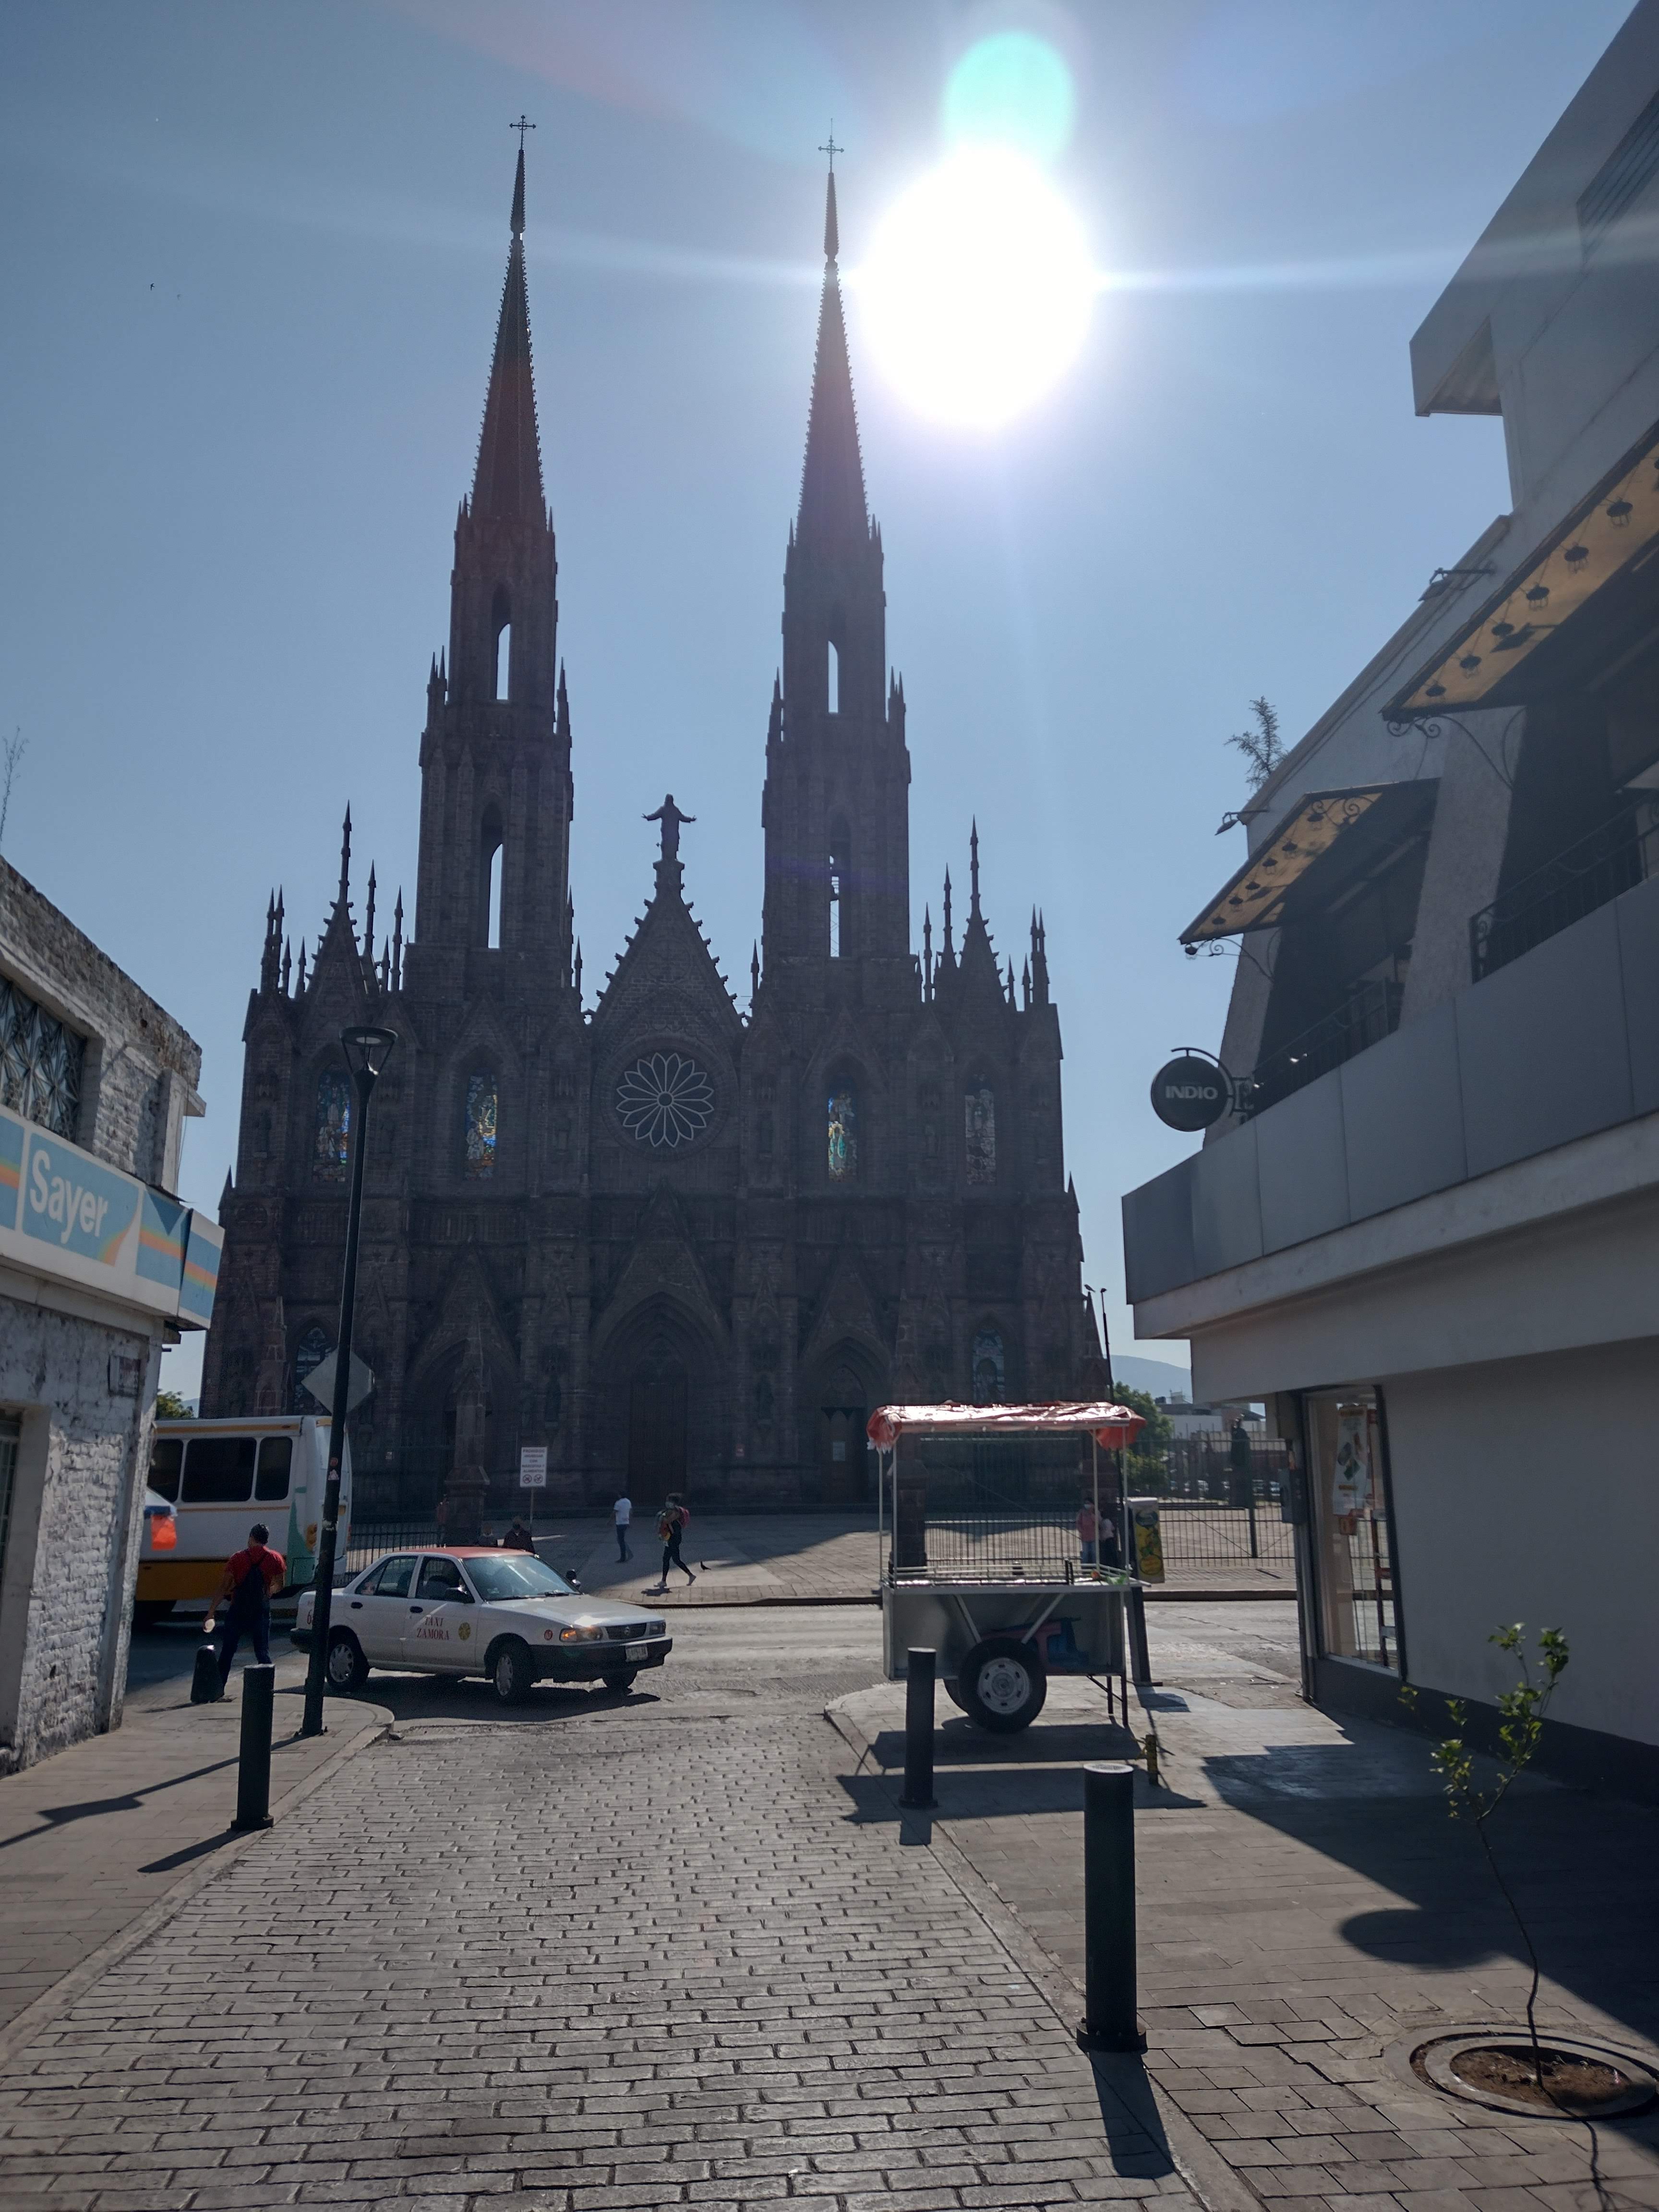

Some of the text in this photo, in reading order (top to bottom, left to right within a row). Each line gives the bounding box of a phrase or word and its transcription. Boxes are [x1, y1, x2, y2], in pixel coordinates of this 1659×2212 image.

[1165, 1085, 1218, 1100] INDIO
[29, 1150, 108, 1244] Sayer
[424, 1616, 444, 1627] TAXI
[416, 1628, 449, 1640] ZAMORA
